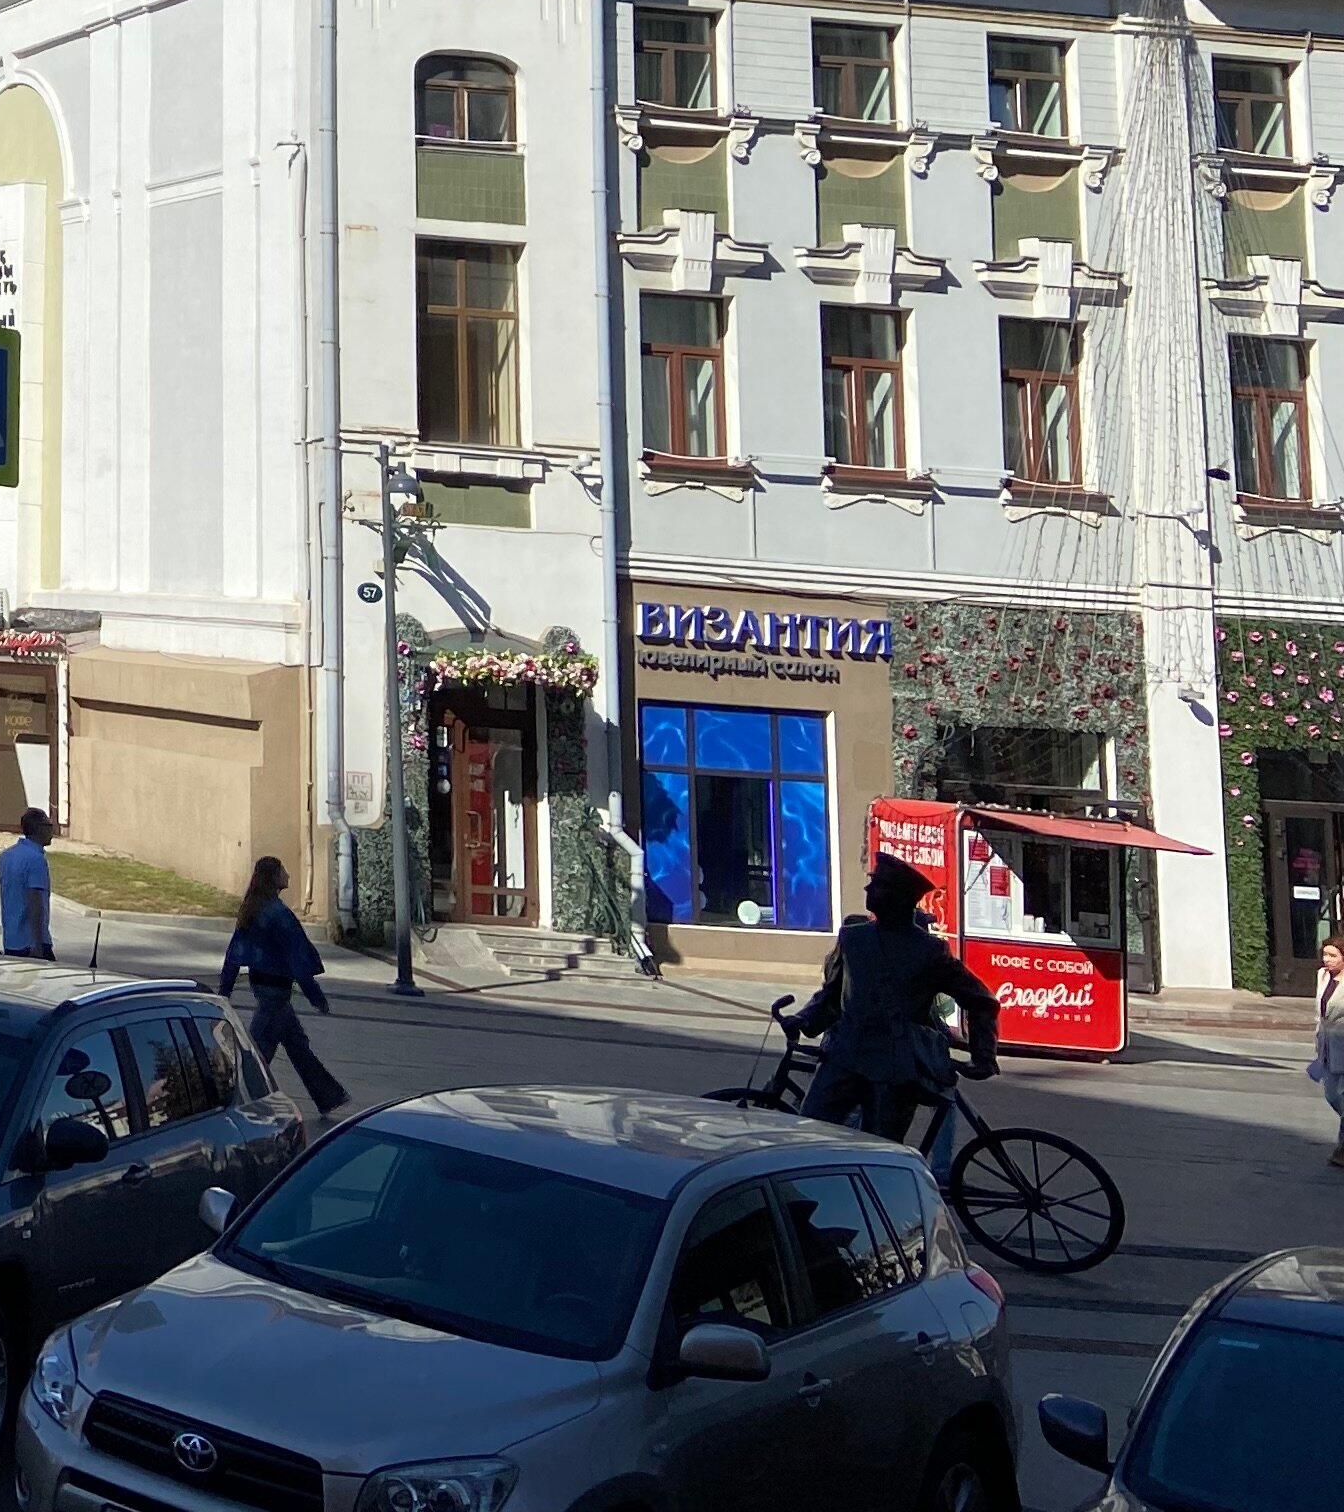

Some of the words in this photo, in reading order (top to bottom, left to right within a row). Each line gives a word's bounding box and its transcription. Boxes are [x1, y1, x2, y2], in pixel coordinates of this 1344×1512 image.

[362, 586, 378, 600] 57
[636, 601, 893, 660] ВИЗАНТИЯ
[638, 649, 769, 679] ювелирный
[771, 661, 840, 684] салон
[991, 954, 1031, 970] КОФЕ
[1034, 958, 1044, 970] С
[1046, 959, 1094, 976] СОБОЙ
[995, 981, 1095, 1015] Сладкий
